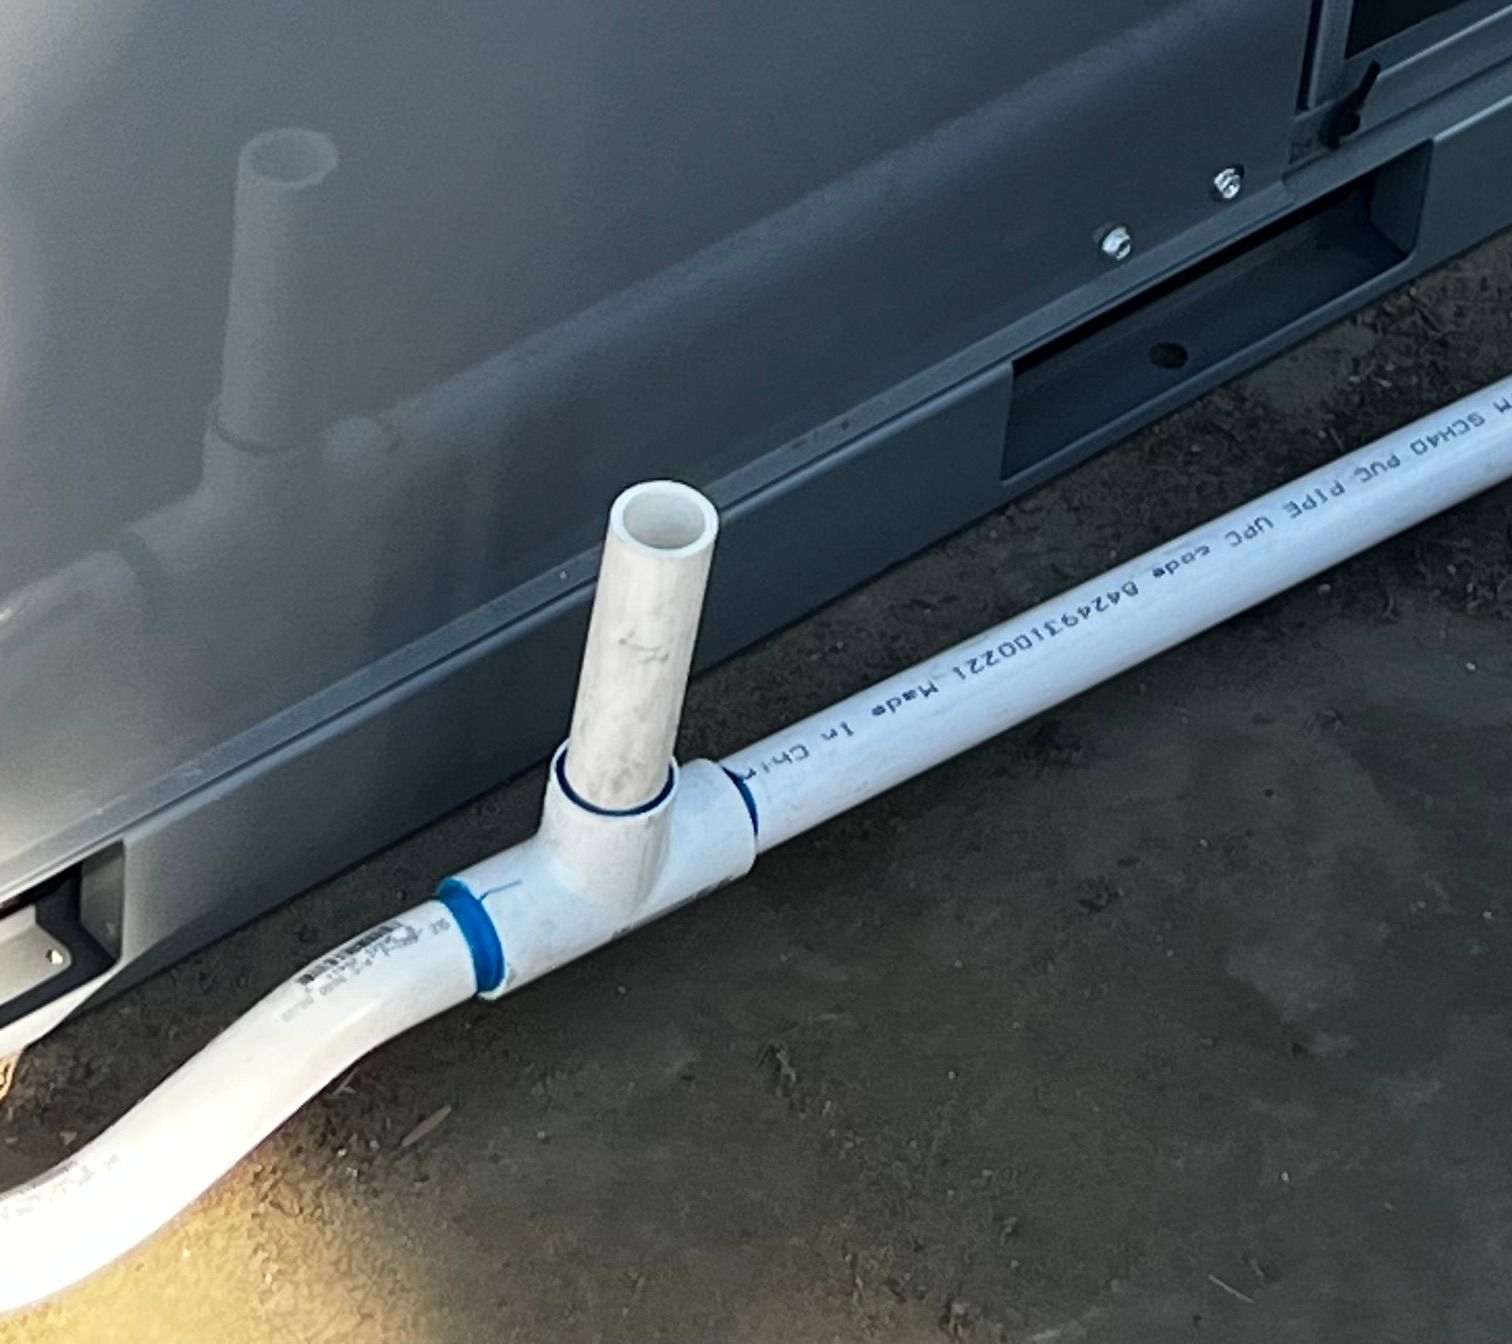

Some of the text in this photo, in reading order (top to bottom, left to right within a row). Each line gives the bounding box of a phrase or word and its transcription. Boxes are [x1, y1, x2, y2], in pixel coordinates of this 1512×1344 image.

[1281, 480, 1346, 519] PIPE
[1225, 516, 1274, 548] UPC
[1152, 545, 1212, 581] code
[870, 679, 939, 717] Made
